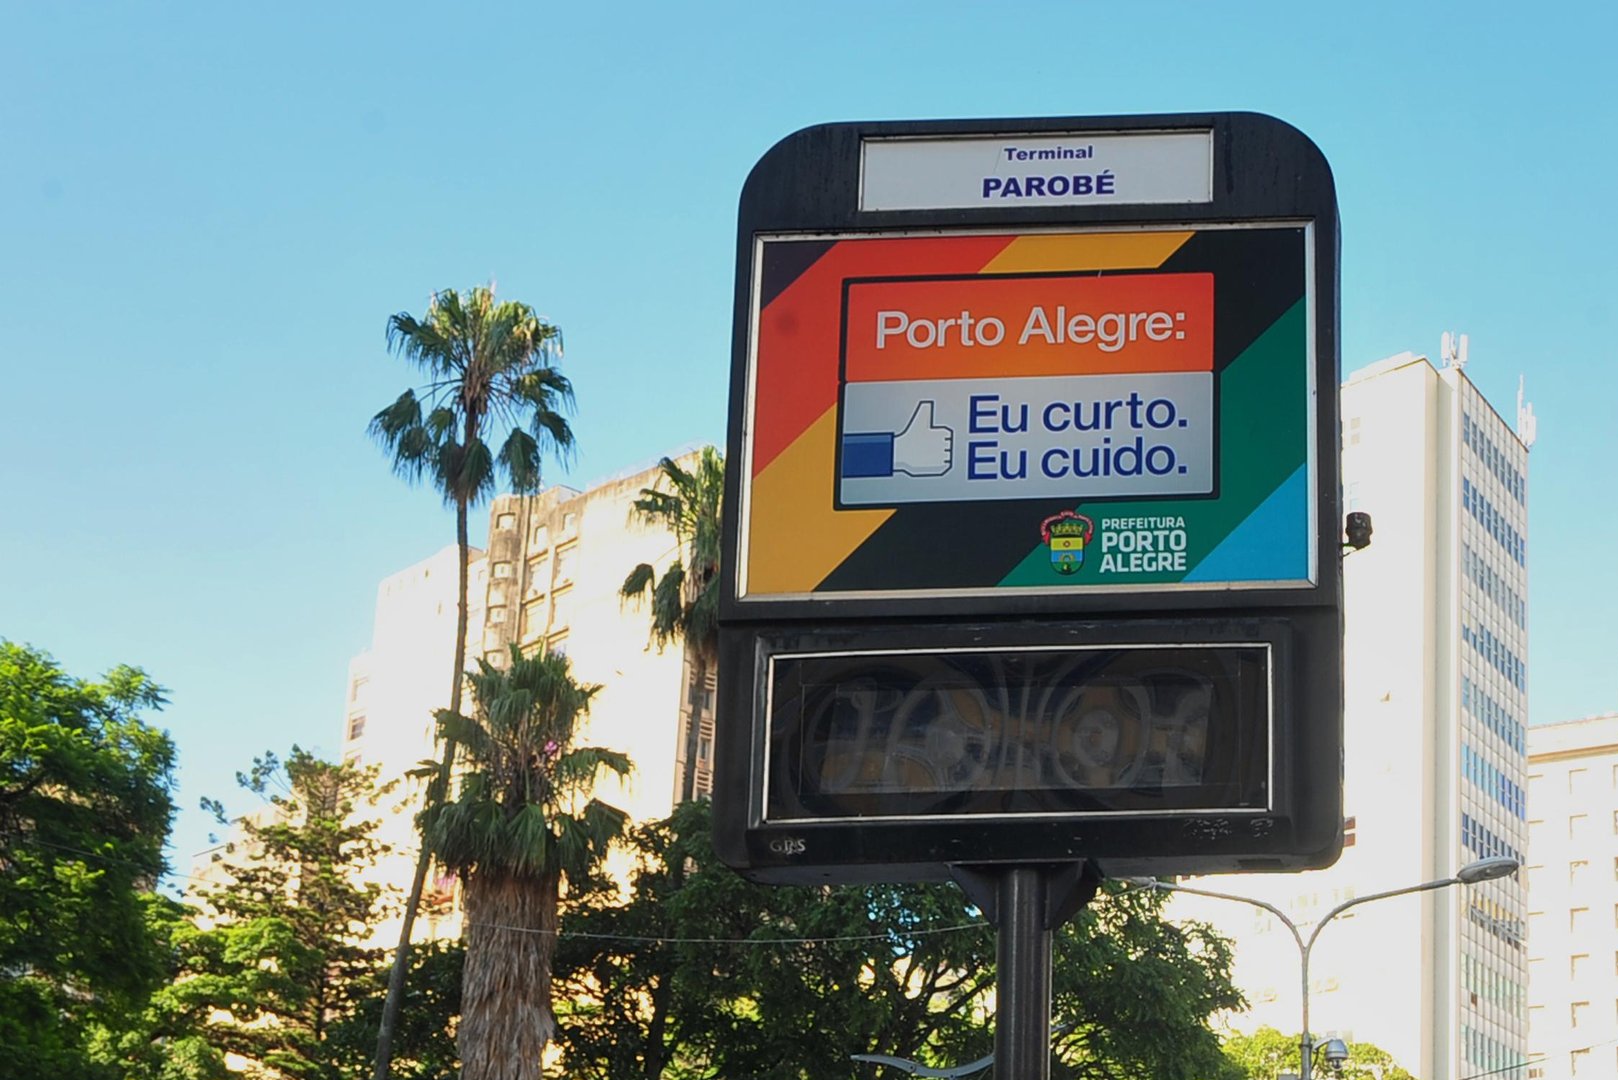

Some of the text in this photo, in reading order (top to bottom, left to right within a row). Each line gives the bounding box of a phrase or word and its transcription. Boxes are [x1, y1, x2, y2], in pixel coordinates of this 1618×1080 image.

[1003, 145, 1093, 161] Terminal
[982, 169, 1115, 198] PAROBÉ
[875, 305, 1186, 353] Porto Alegre:
[967, 392, 1189, 434] Eu curto.
[966, 436, 1188, 480] Eu cuido.
[1101, 516, 1185, 530] PREFEITURA
[1101, 529, 1187, 553] PORTO
[1099, 552, 1187, 573] ALEGRE
